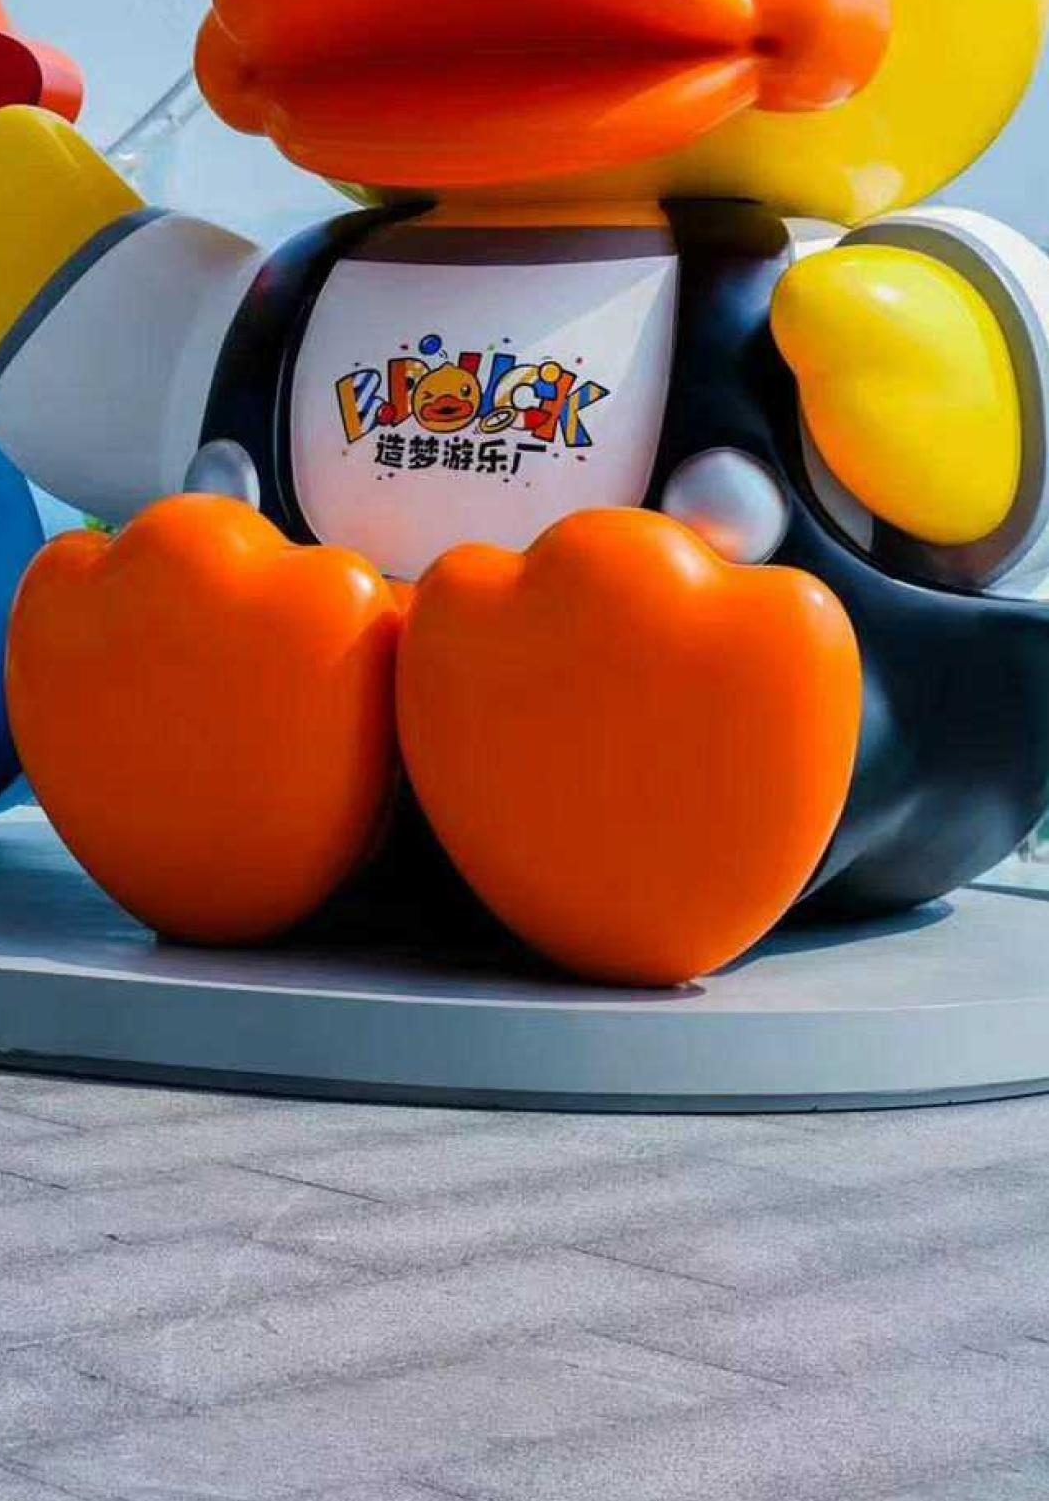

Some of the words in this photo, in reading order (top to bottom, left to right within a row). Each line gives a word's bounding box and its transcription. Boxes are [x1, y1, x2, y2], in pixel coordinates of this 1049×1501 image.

[374, 433, 548, 475] 造梦游乐厂
